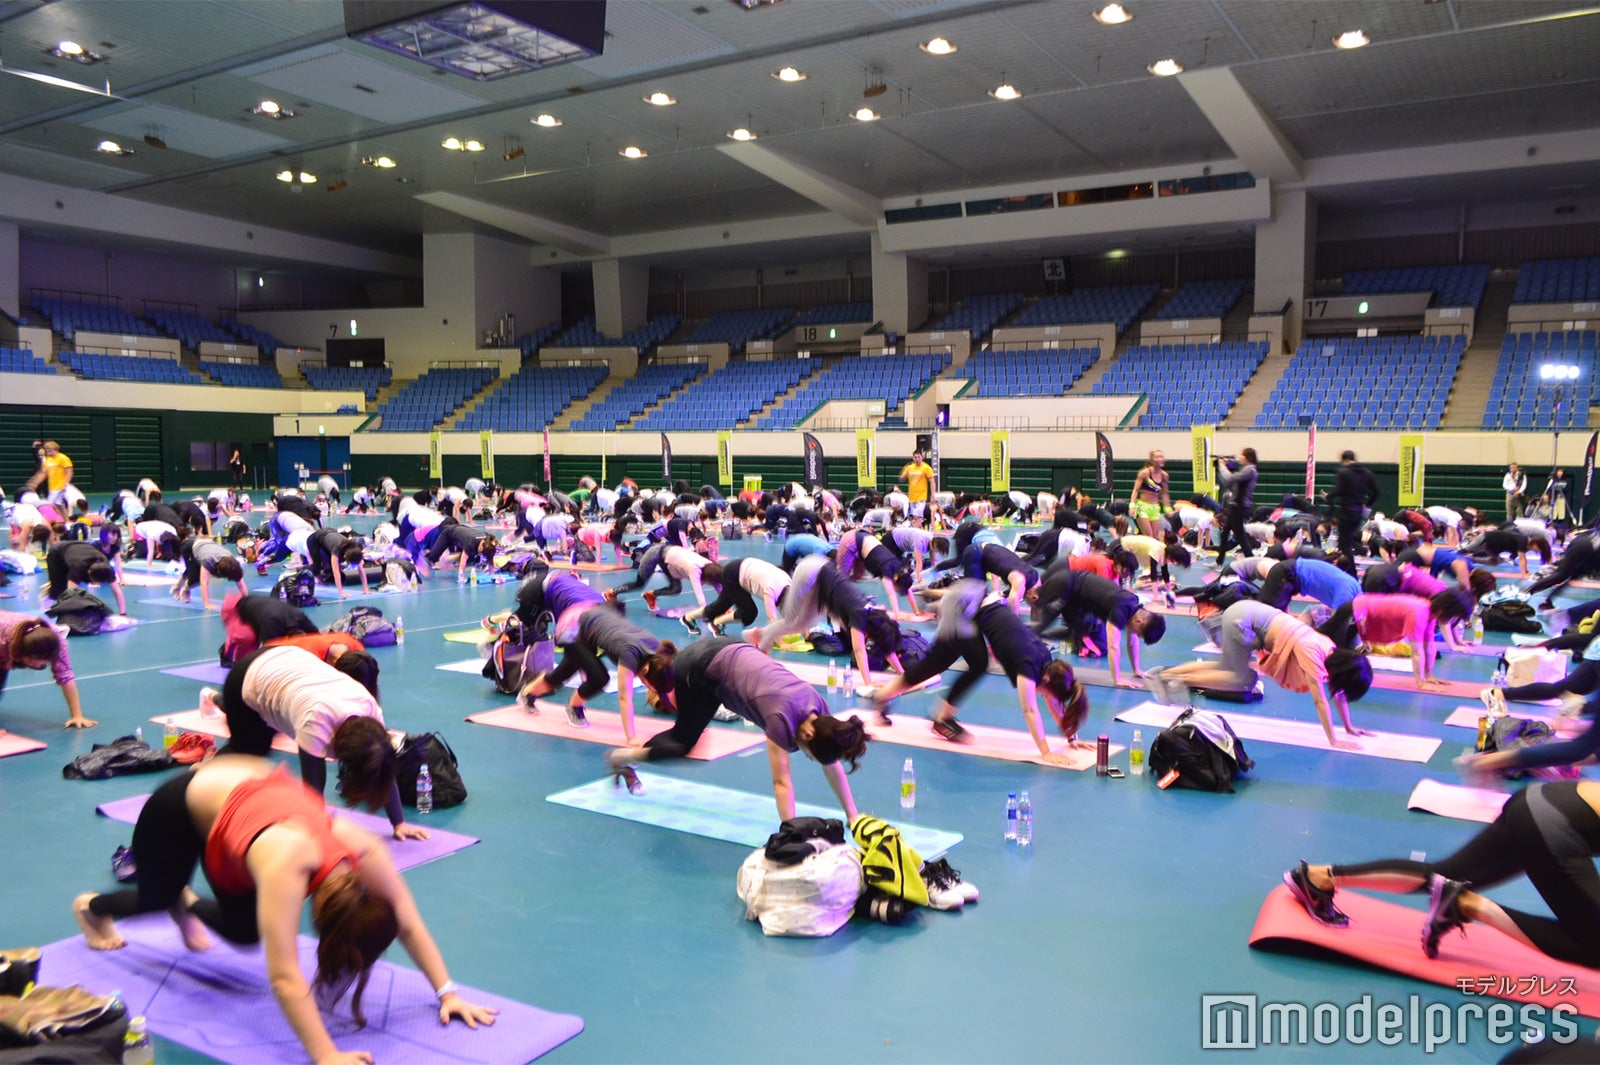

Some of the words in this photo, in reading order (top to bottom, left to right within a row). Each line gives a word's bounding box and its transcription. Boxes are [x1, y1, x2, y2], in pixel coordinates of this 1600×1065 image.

[1308, 300, 1328, 317] 17
[330, 324, 337, 337] 7
[803, 328, 817, 341] 18
[295, 420, 299, 434] 1
